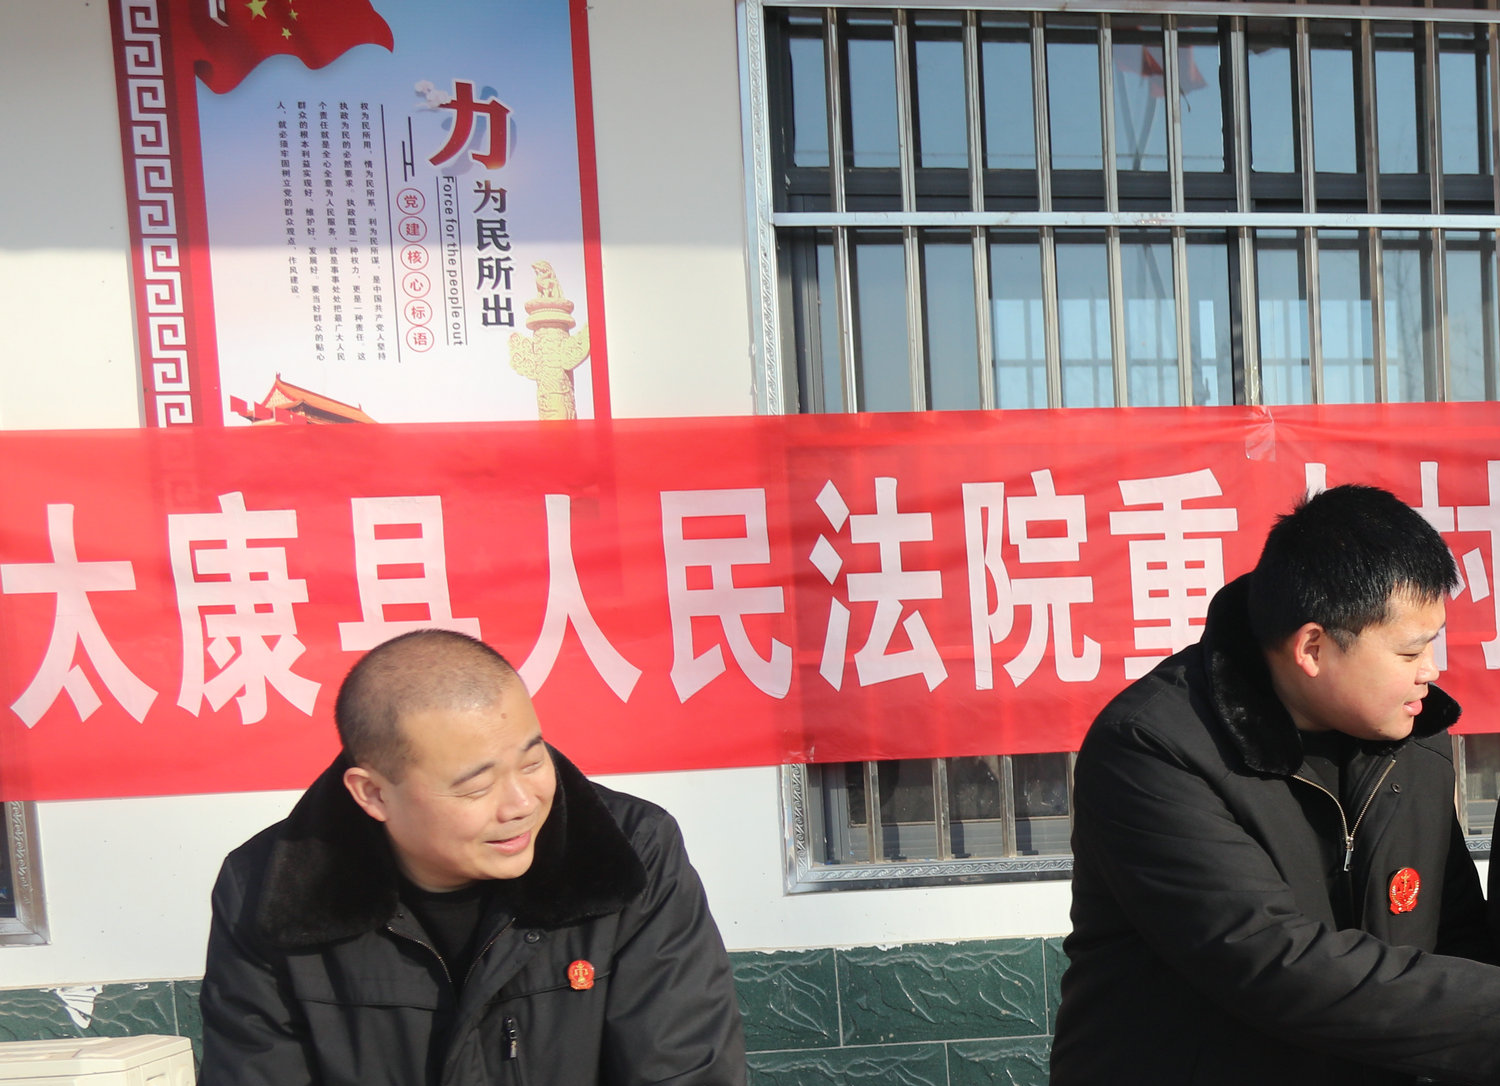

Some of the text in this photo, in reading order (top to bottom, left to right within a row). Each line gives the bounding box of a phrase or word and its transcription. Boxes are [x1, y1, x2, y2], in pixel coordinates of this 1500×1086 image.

[402, 193, 430, 348] 党建核心标语
[427, 80, 515, 328] 力 为民所出
[442, 176, 464, 346] Force for the people out
